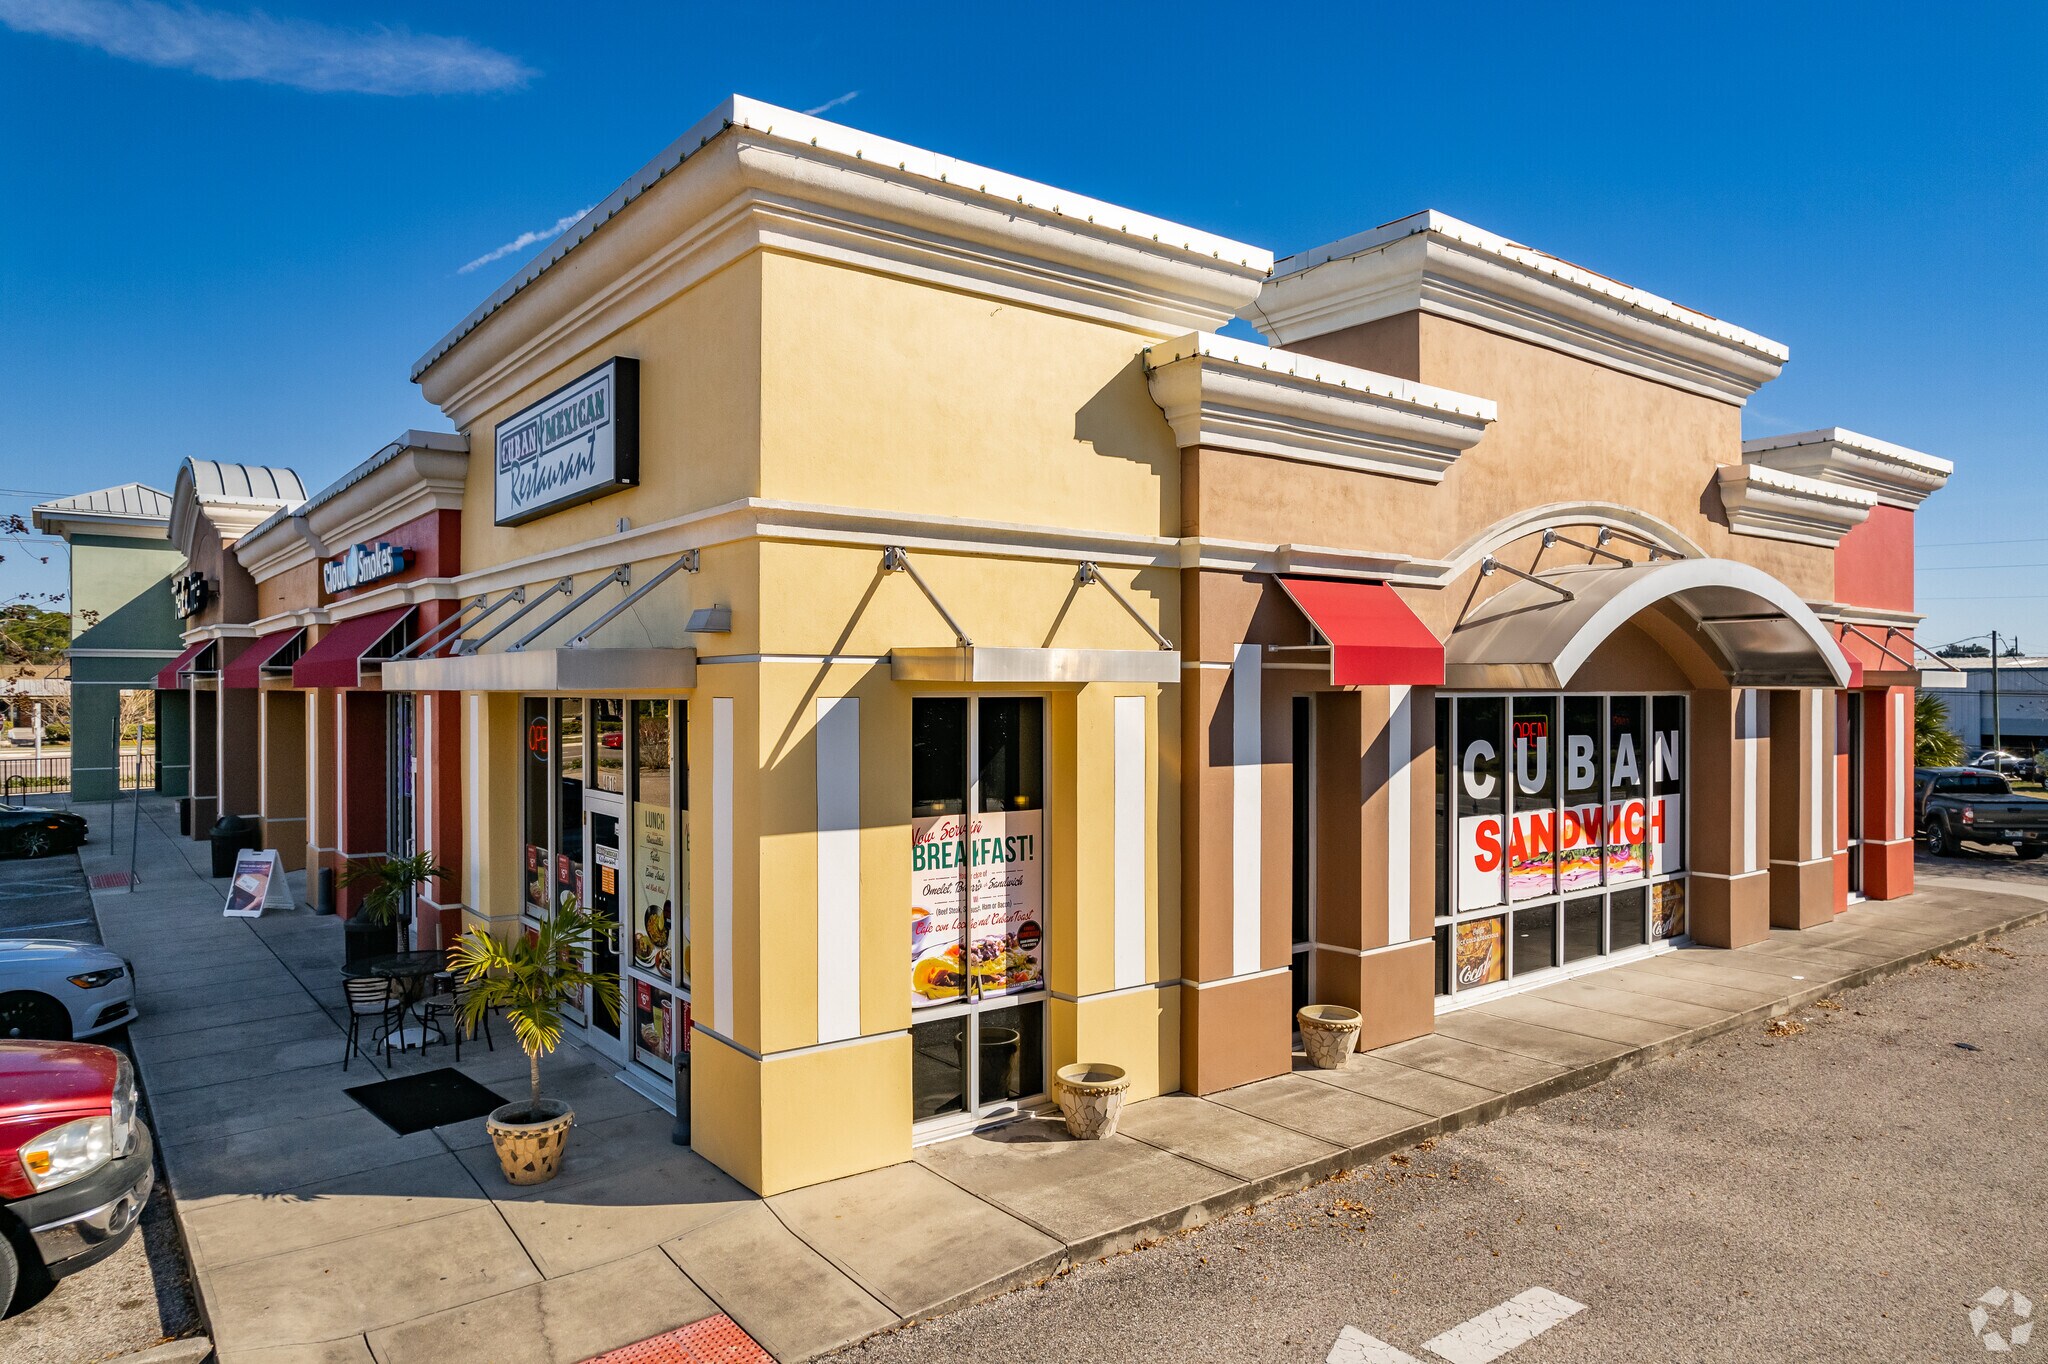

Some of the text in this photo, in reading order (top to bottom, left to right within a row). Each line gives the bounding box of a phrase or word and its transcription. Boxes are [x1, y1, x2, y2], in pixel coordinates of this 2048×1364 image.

[501, 426, 536, 465] CUBAN
[545, 388, 605, 446] MEXICAN
[511, 427, 596, 510] Restaurant
[323, 542, 394, 594] Cloud Smokes
[1463, 730, 1679, 799] CUBAN
[1513, 722, 1547, 748] OPEN
[645, 810, 665, 831] LUNCH
[1474, 800, 1666, 872] SANDWICH
[988, 875, 1024, 890] Sandwich
